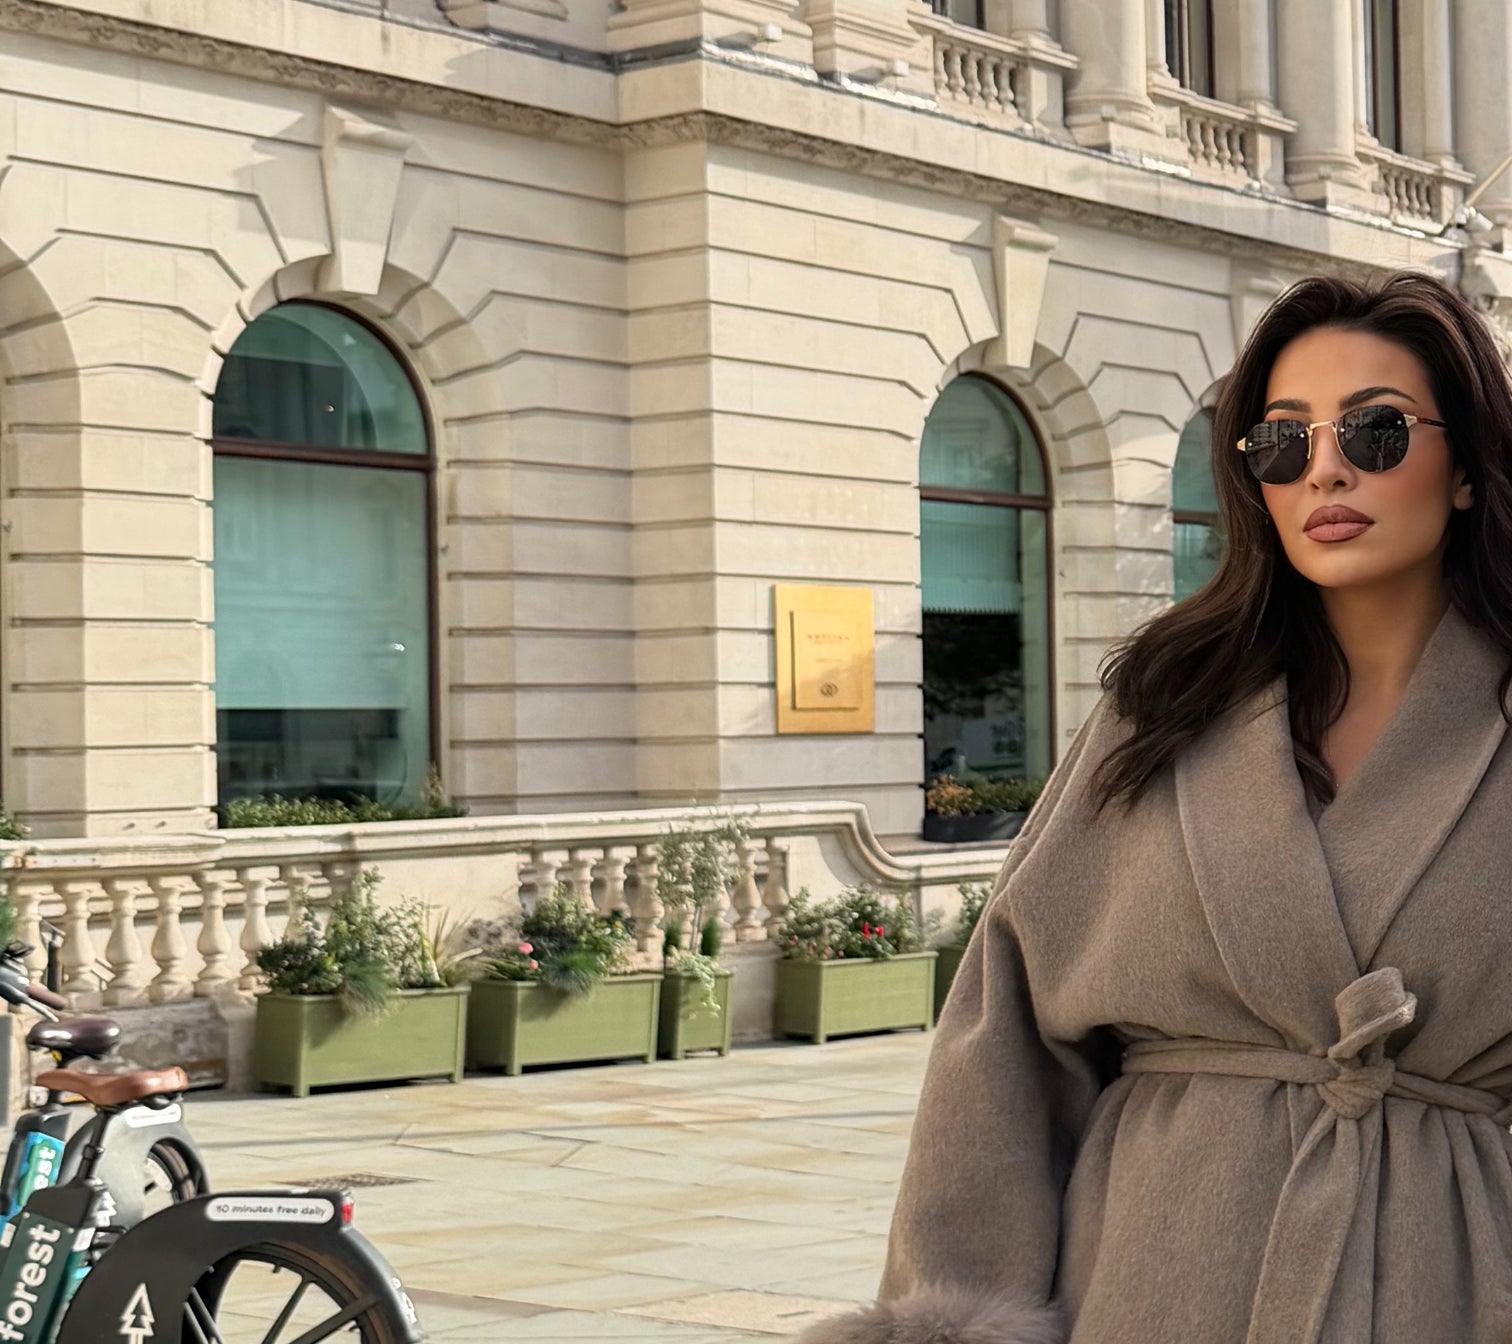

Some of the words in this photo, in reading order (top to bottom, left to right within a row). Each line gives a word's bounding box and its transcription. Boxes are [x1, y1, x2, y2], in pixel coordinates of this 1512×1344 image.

[231, 1204, 274, 1214] minutes
[276, 1205, 299, 1215] free
[300, 1205, 327, 1217] daily
[0, 1223, 61, 1342] forest
